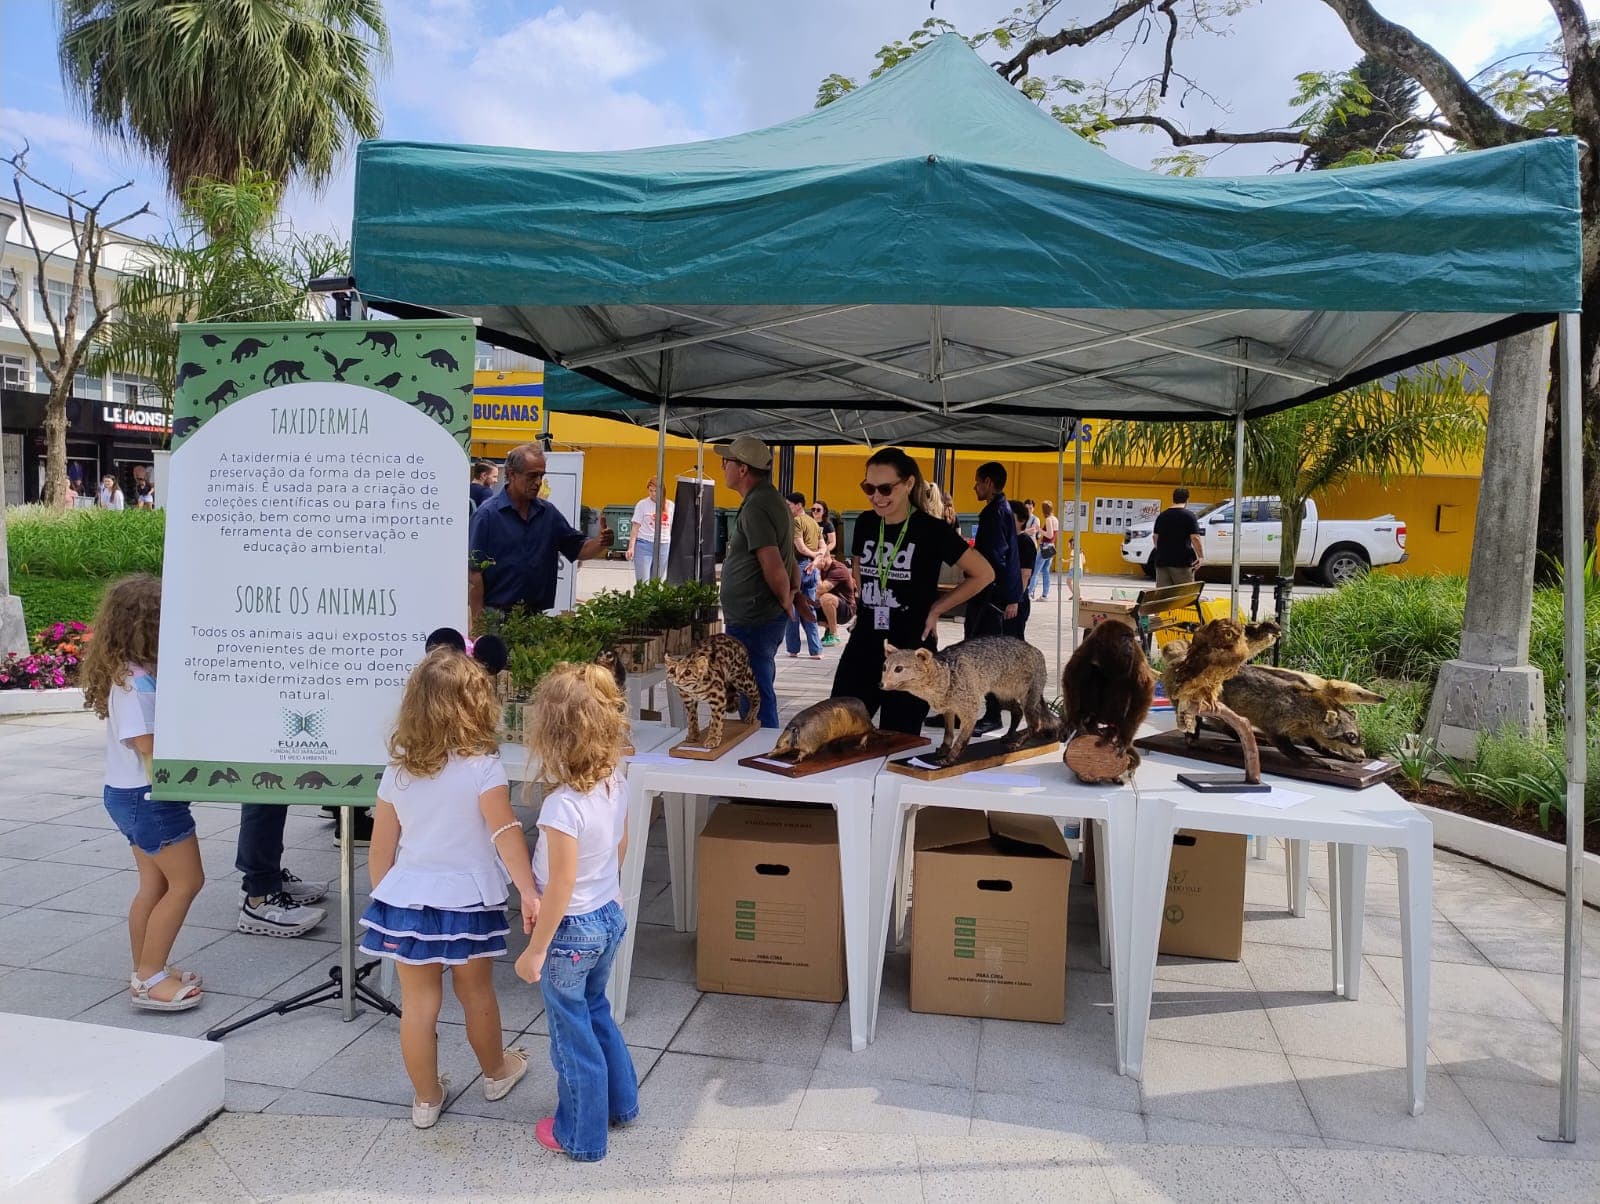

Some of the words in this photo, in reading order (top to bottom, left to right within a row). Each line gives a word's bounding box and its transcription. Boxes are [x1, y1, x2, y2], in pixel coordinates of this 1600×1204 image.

[104, 407, 122, 422] LE
[124, 409, 173, 427] MONSIE
[271, 408, 368, 435] TAXIDERMIA
[1071, 423, 1092, 442] S
[220, 453, 227, 462] A
[232, 452, 299, 462] taxidermia
[305, 452, 311, 462] é
[317, 455, 345, 463] uma
[351, 452, 400, 463] técnica
[406, 453, 424, 464] de
[210, 467, 284, 481] preservação
[289, 467, 304, 477] da
[310, 467, 348, 477] forma
[354, 467, 370, 478] da
[376, 468, 405, 480] pele
[411, 468, 436, 480] dos
[208, 482, 256, 492] animais.
[263, 480, 269, 492] É
[274, 481, 312, 492] usada
[318, 485, 346, 495] para
[352, 485, 358, 493] a
[364, 483, 415, 496] criação
[421, 484, 438, 495] de
[205, 496, 257, 511] coleções
[262, 497, 328, 507] científicas
[333, 500, 349, 508] ou
[356, 500, 385, 510] para
[392, 498, 417, 509] fins
[422, 499, 439, 510] de
[192, 511, 255, 526] exposição,
[260, 511, 288, 522] bem
[293, 513, 330, 523] como
[336, 515, 366, 523] uma
[372, 513, 453, 526] importante
[220, 526, 291, 537] ferramenta
[296, 527, 312, 537] de
[317, 529, 405, 543] conservação
[244, 541, 306, 555] educação
[311, 540, 386, 554] ambiental.
[235, 585, 281, 613] SOBRE
[290, 587, 308, 614] OS
[317, 587, 396, 616] ANIMAIS
[192, 626, 227, 637] Todos
[231, 628, 245, 637] os
[250, 628, 302, 639] animais
[307, 632, 337, 644] aqui
[343, 632, 407, 643] expostos
[412, 632, 428, 642] sã
[217, 643, 304, 658] provenientes
[309, 644, 326, 655] de
[332, 647, 375, 656] morte
[381, 648, 404, 659] por
[185, 656, 284, 672] atropelamento,
[290, 659, 339, 670] velhice
[194, 671, 230, 682] foram
[234, 672, 341, 686] taxidermizados
[375, 678, 405, 688] post
[280, 689, 333, 700] natural.
[278, 739, 328, 749] FUJAMA
